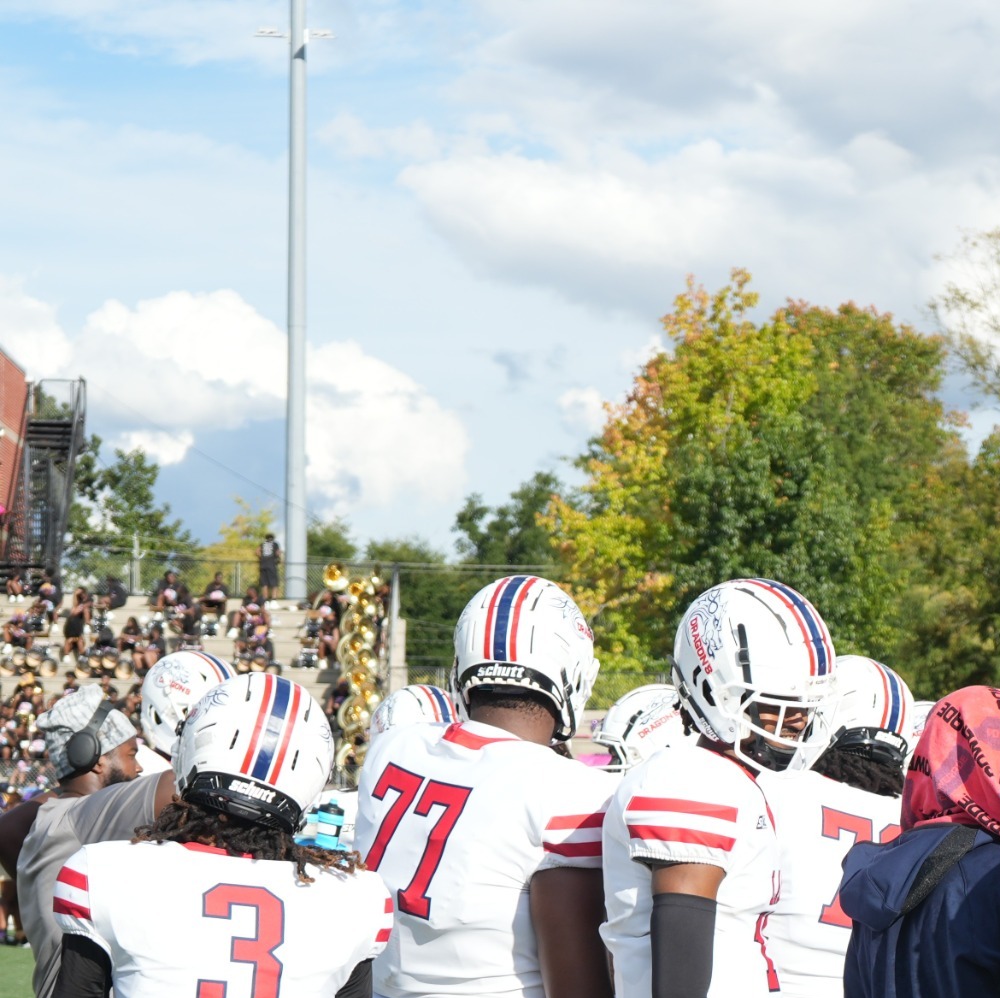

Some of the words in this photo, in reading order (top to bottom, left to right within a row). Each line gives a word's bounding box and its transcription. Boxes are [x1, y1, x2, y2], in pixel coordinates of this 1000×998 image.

[477, 663, 525, 678] schutt
[229, 779, 277, 803] schutt
[364, 761, 473, 920] 77
